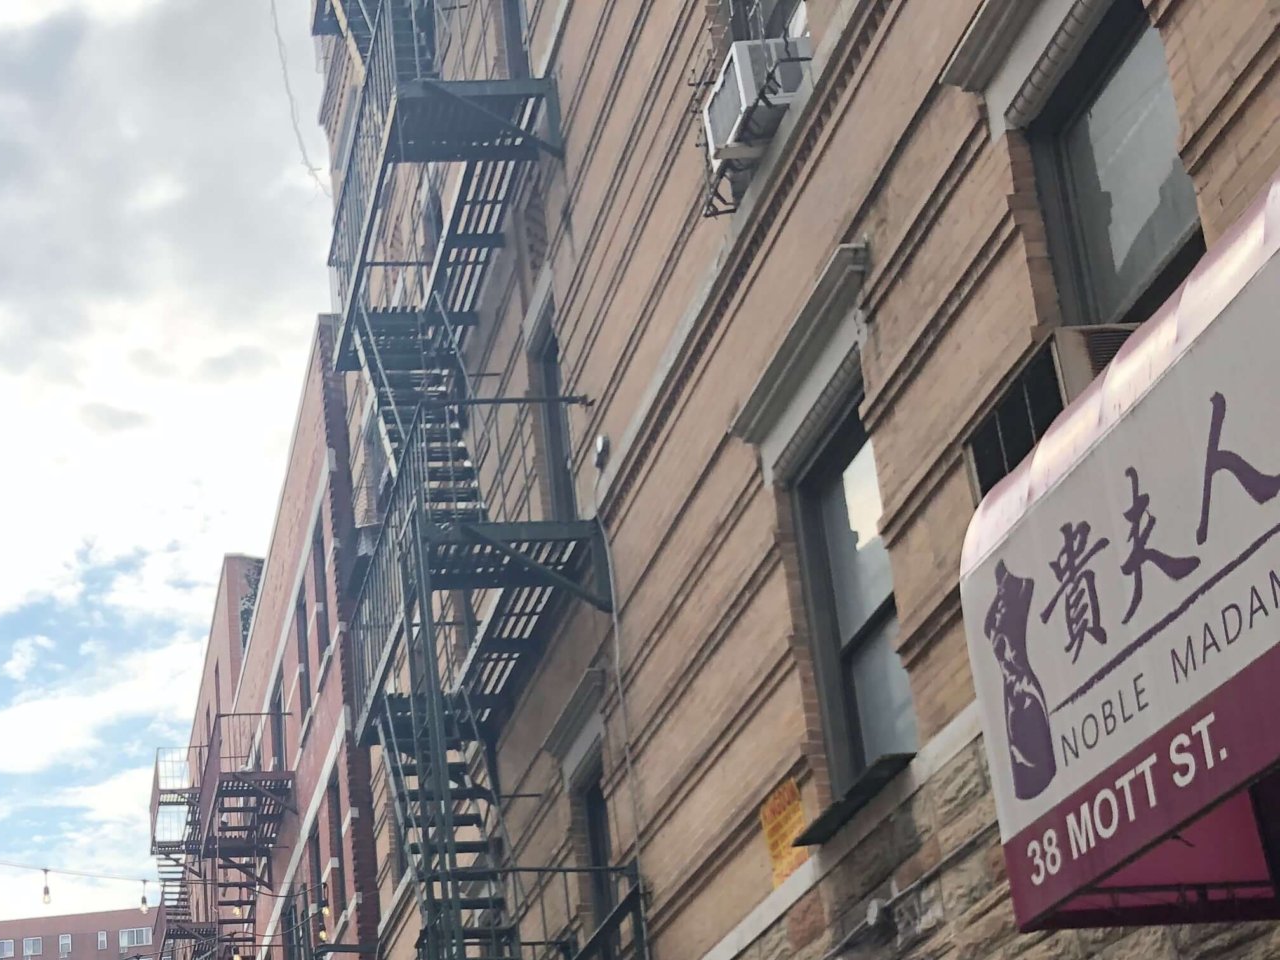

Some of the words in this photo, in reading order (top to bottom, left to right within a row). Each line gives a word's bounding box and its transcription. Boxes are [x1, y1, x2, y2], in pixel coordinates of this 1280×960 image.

[1040, 390, 1280, 665] 貴夫人
[1026, 829, 1061, 887] 38
[1066, 753, 1158, 860] MOTT
[1169, 711, 1228, 788] ST.
[1061, 672, 1150, 767] NOBLE
